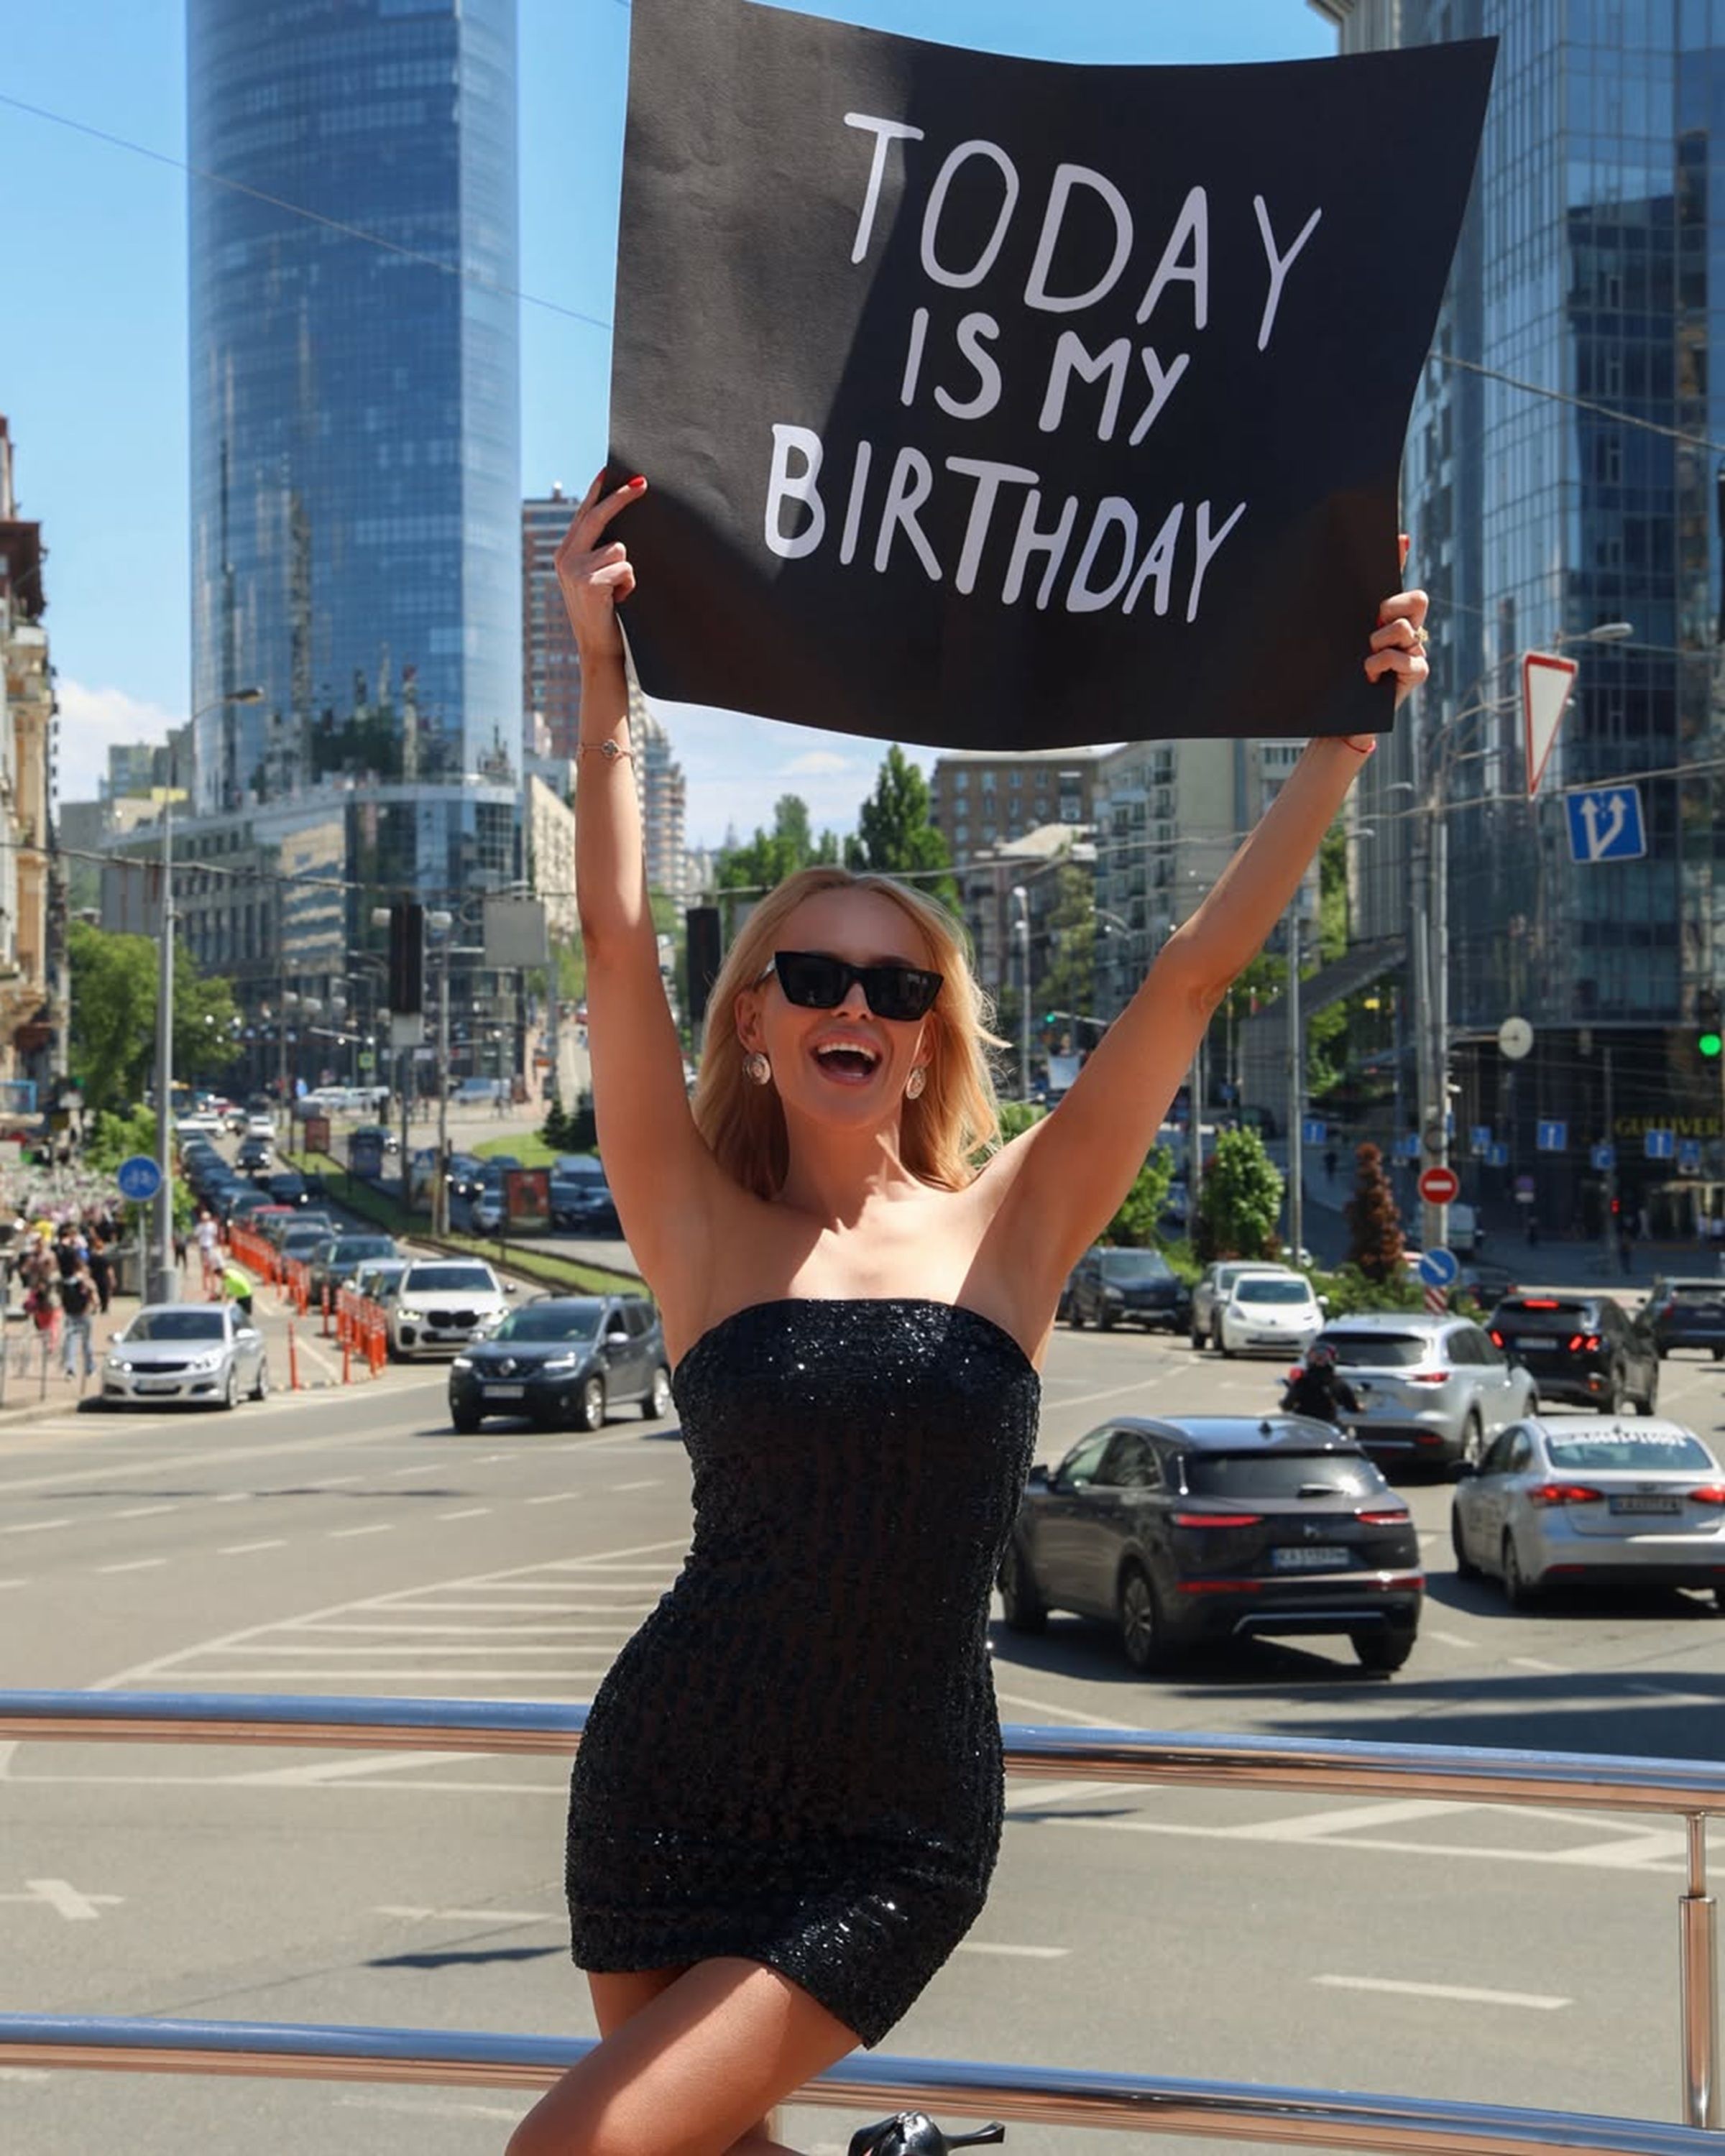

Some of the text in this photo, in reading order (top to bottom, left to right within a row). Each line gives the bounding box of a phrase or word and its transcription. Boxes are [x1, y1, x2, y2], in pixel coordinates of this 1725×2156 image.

[843, 111, 1322, 350] TODAY
[901, 308, 1190, 446] IS MY
[764, 423, 1246, 622] BIRTHDAY
